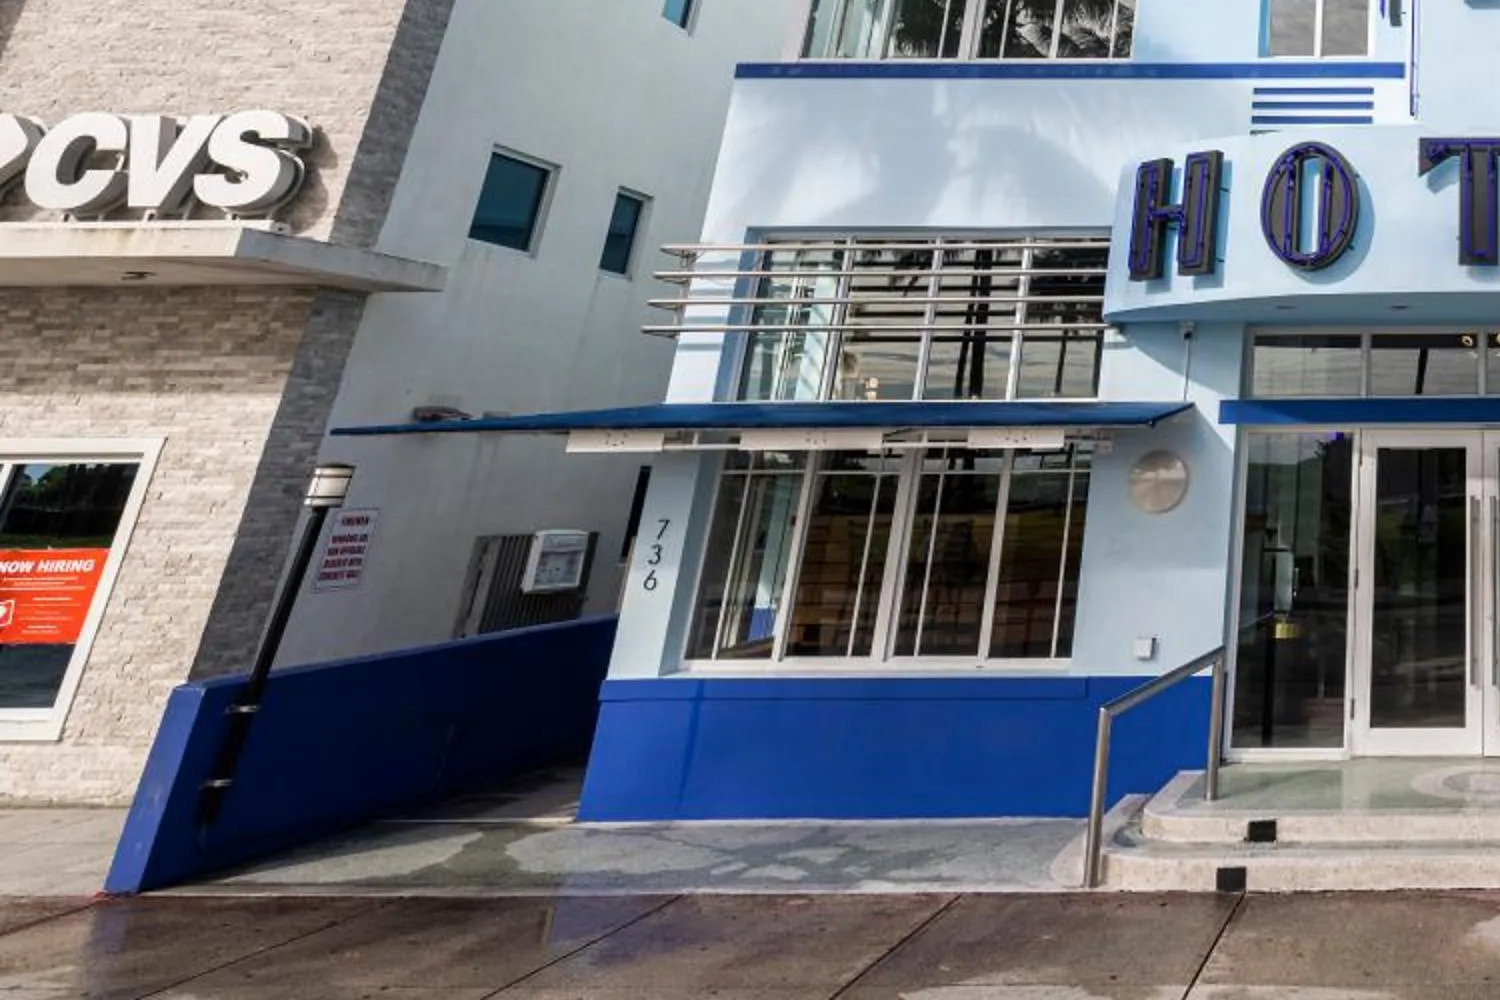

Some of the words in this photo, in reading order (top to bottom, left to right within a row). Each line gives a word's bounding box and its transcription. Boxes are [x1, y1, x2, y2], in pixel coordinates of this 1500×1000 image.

[25, 109, 311, 213] CVS
[37, 559, 95, 573] HIRING
[643, 518, 671, 591] 736
